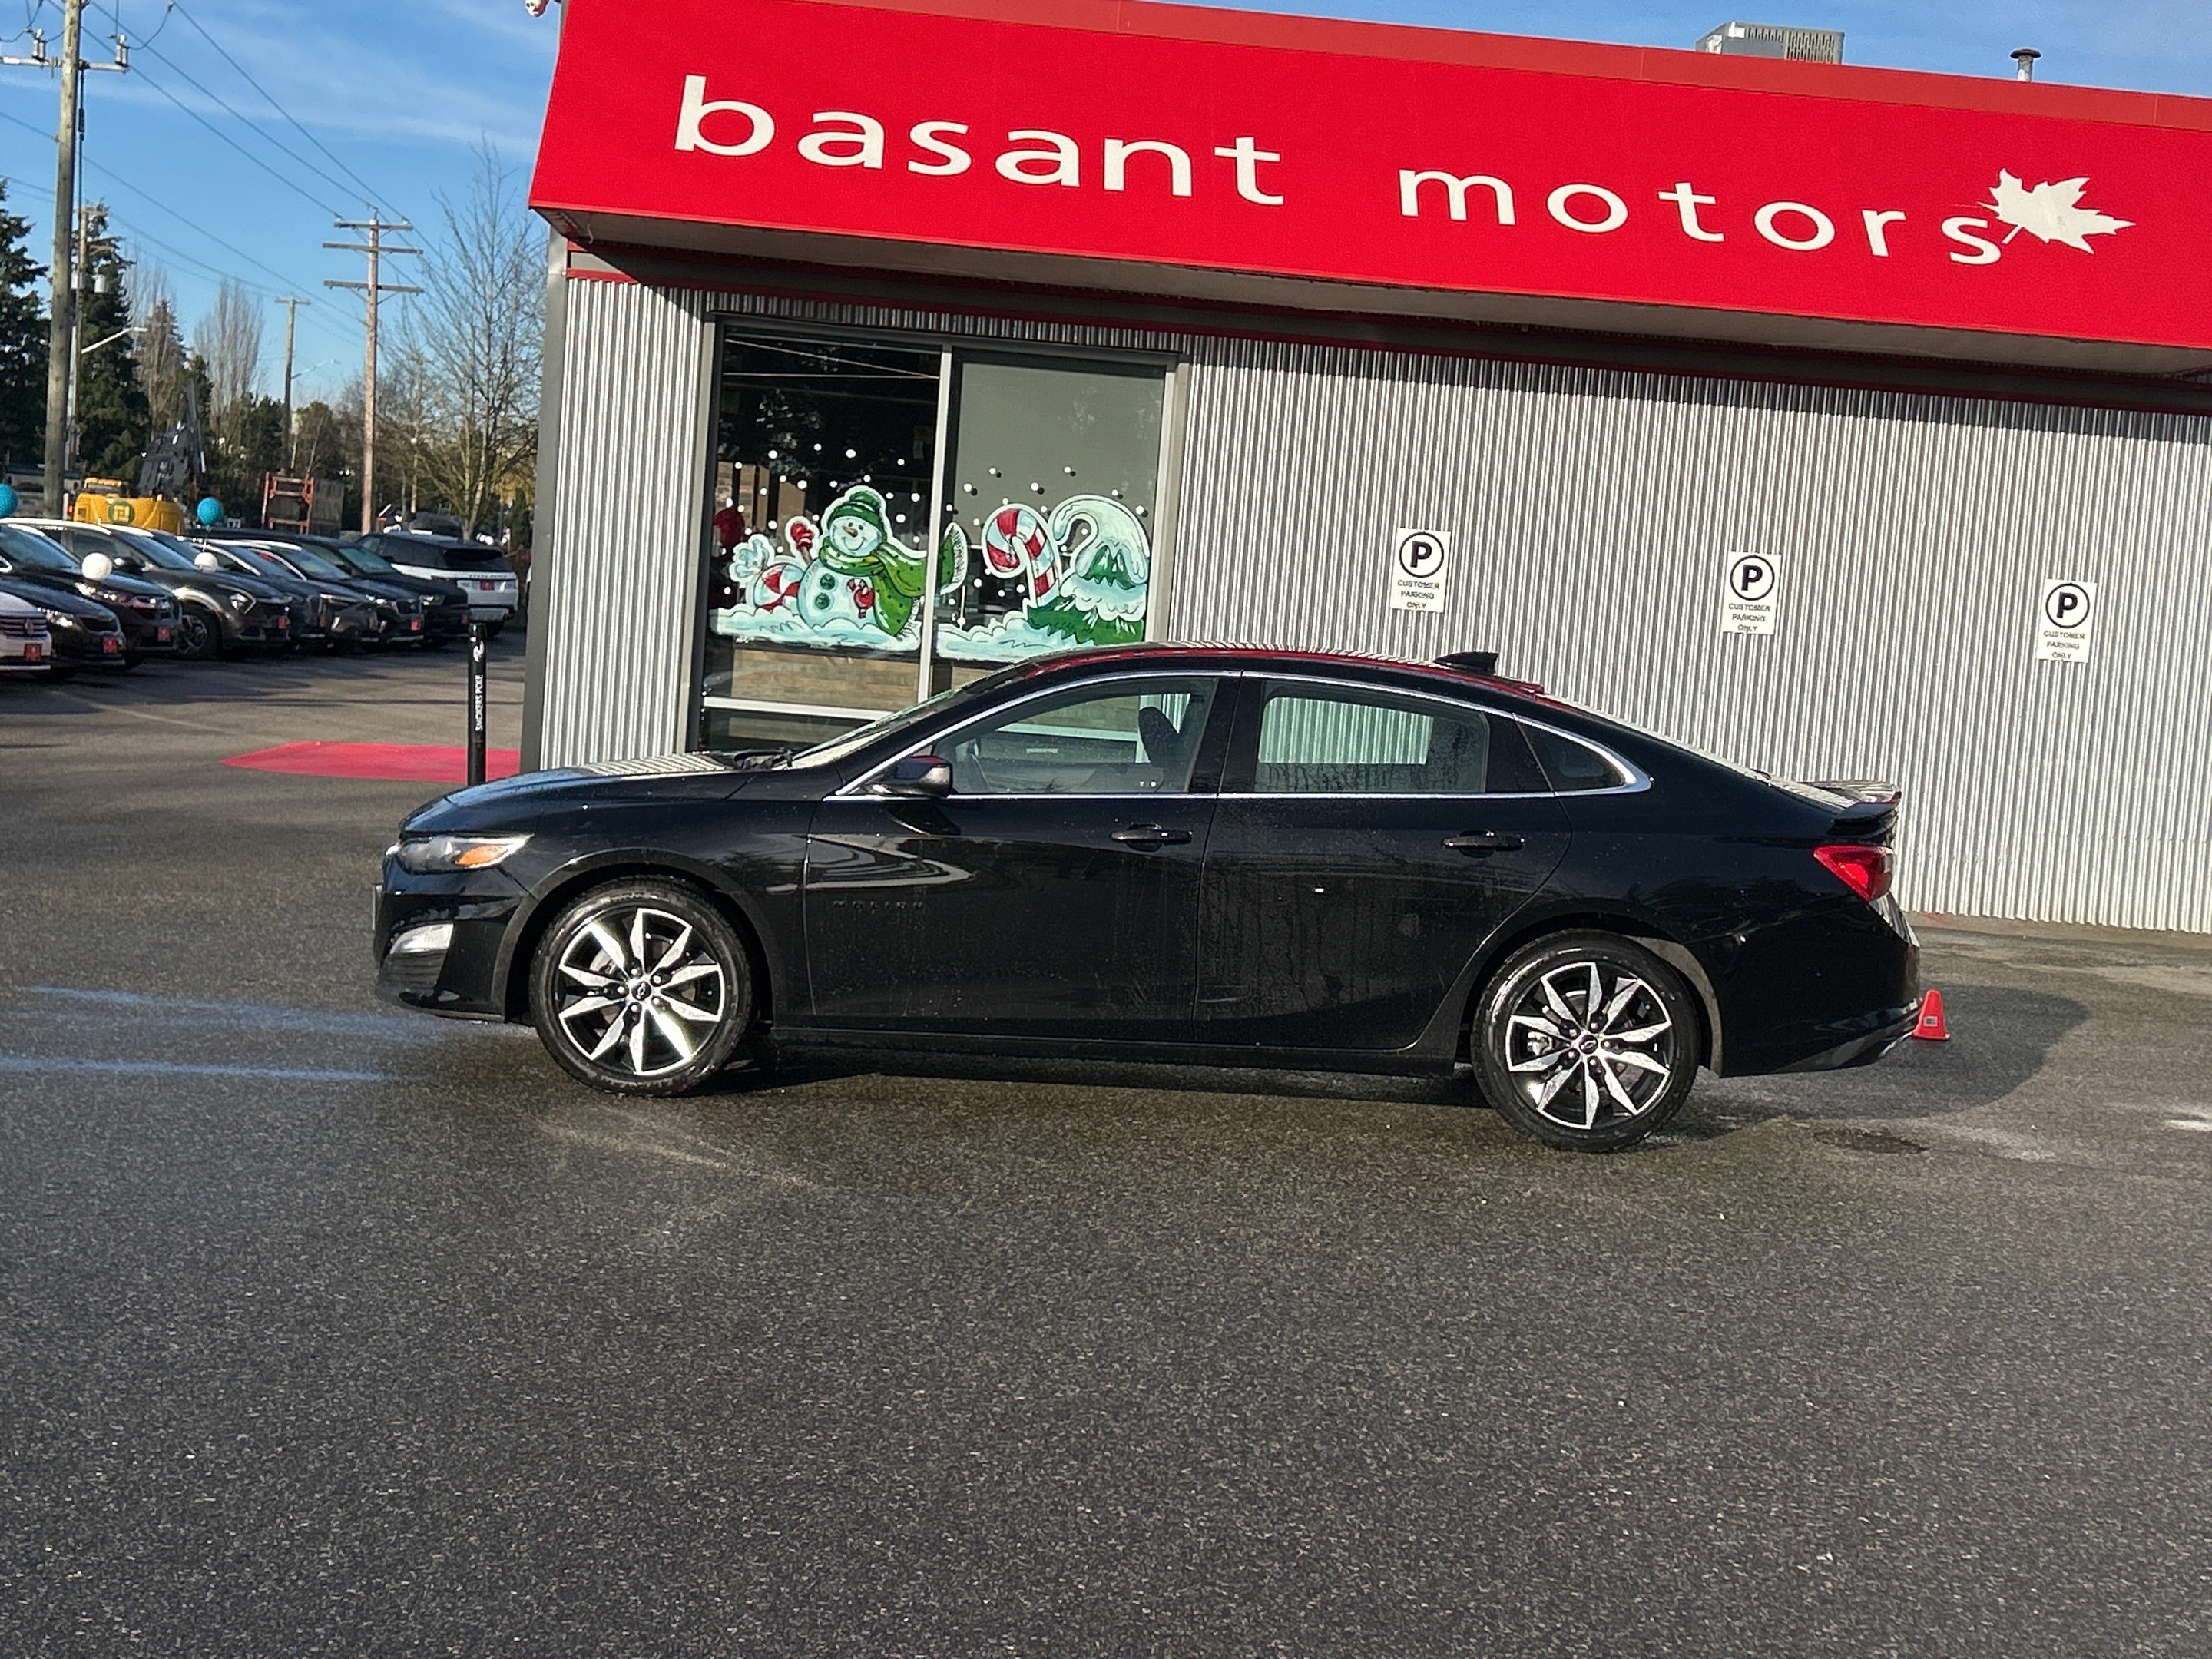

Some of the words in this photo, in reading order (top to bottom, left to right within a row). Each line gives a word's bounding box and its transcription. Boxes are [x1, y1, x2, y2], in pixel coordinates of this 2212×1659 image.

[674, 74, 1285, 205] basant
[1398, 168, 2002, 266] motors
[1410, 541, 1432, 568] P
[1397, 579, 1440, 589] CUSTOMER
[1741, 564, 1763, 591] P
[1728, 602, 1771, 612] CUSTOMER
[2056, 591, 2078, 618] P
[2043, 630, 2086, 640] CUSTOMER
